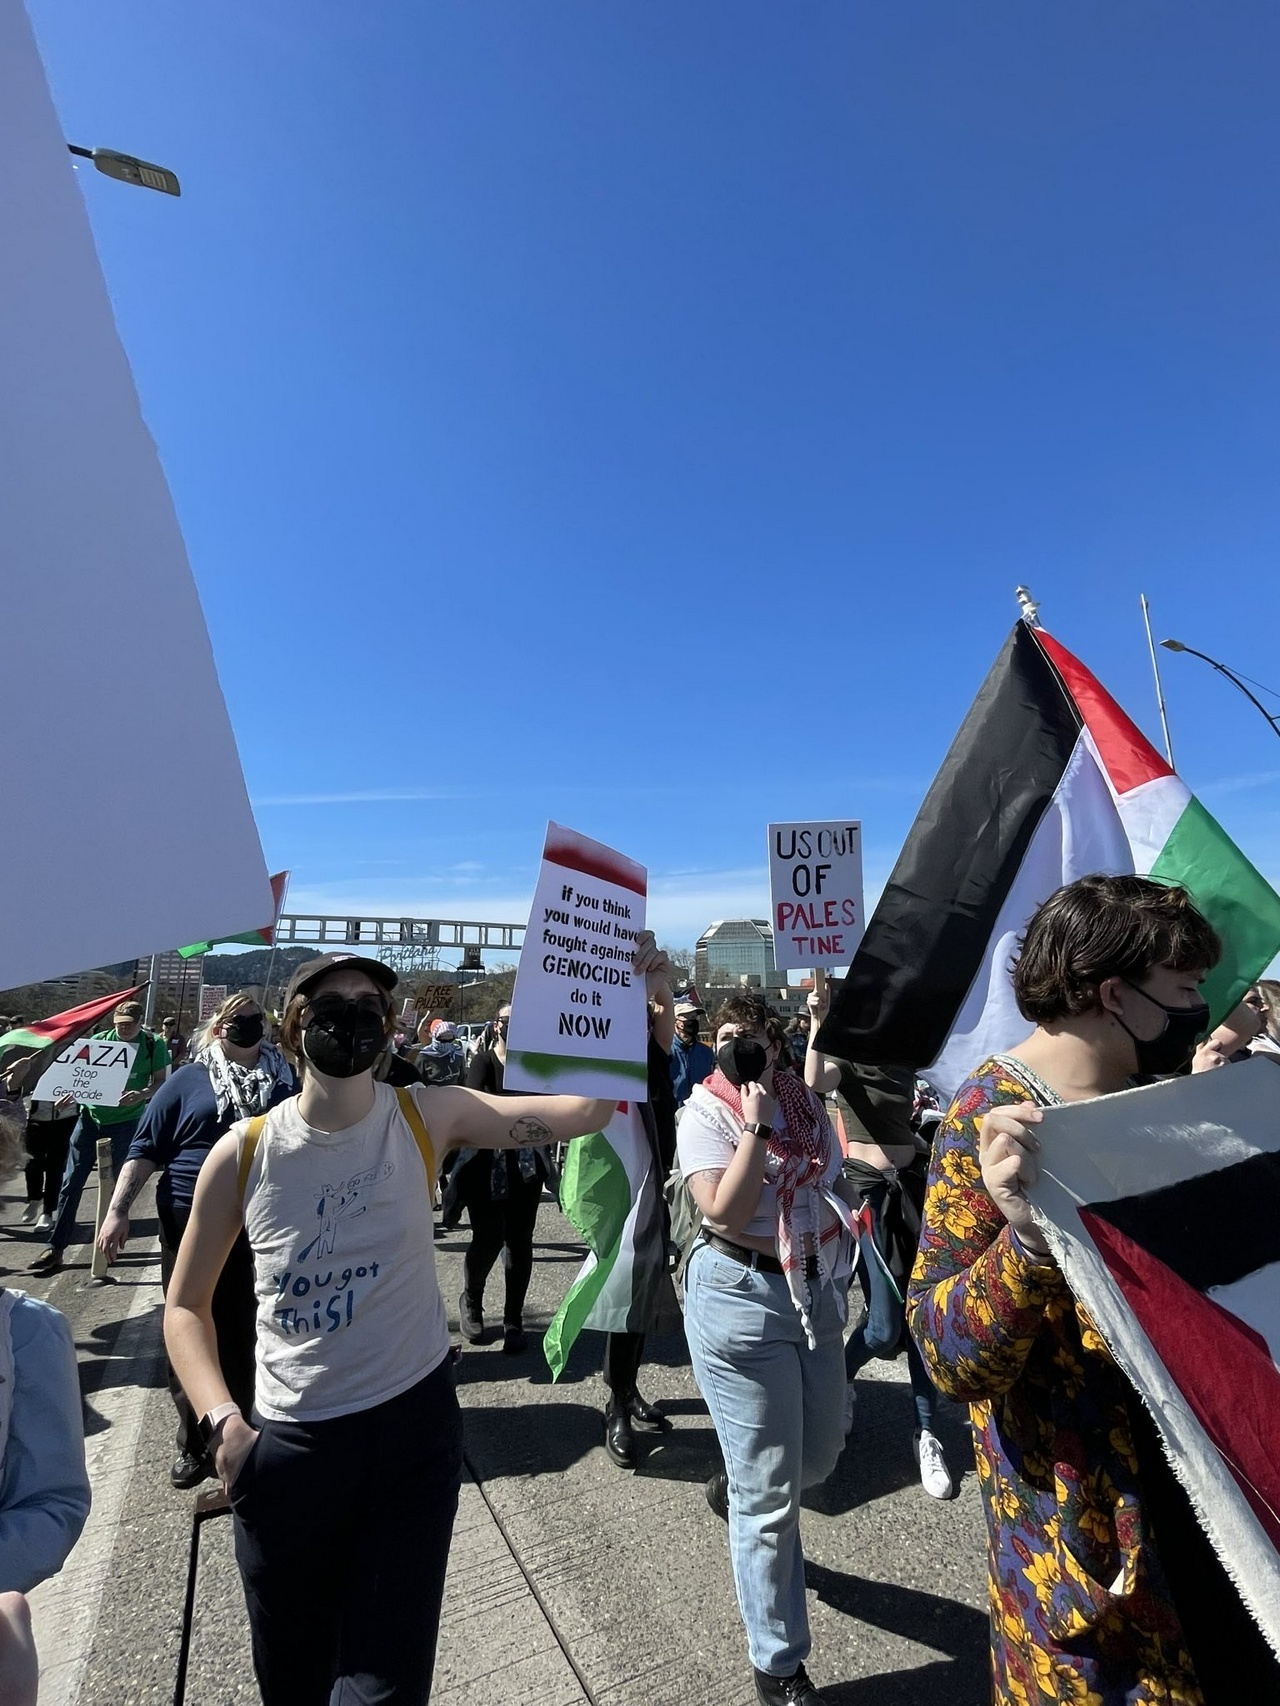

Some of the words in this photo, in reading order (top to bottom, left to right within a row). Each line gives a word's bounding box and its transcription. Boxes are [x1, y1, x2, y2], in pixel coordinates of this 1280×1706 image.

[777, 830, 812, 859] US
[818, 827, 858, 858] OUT
[793, 864, 832, 897] OF
[562, 885, 573, 902] if
[575, 893, 599, 910] you
[603, 899, 631, 919] think
[777, 899, 855, 931] PALES
[543, 908, 569, 925] you
[573, 916, 611, 936] would
[543, 929, 587, 953] fought
[590, 943, 636, 963] against
[792, 935, 845, 955] TINE
[543, 955, 631, 988] GENOCIDE
[415, 997, 453, 1010] PALESTINE
[425, 985, 453, 996] FREE
[571, 989, 587, 1004] do
[592, 991, 602, 1006] it
[559, 1013, 611, 1039] NOW
[72, 1067, 98, 1079] Stop
[73, 1079, 90, 1088] the
[53, 1086, 102, 1100] Genocide
[273, 1271, 332, 1302] You
[335, 1261, 379, 1291] got
